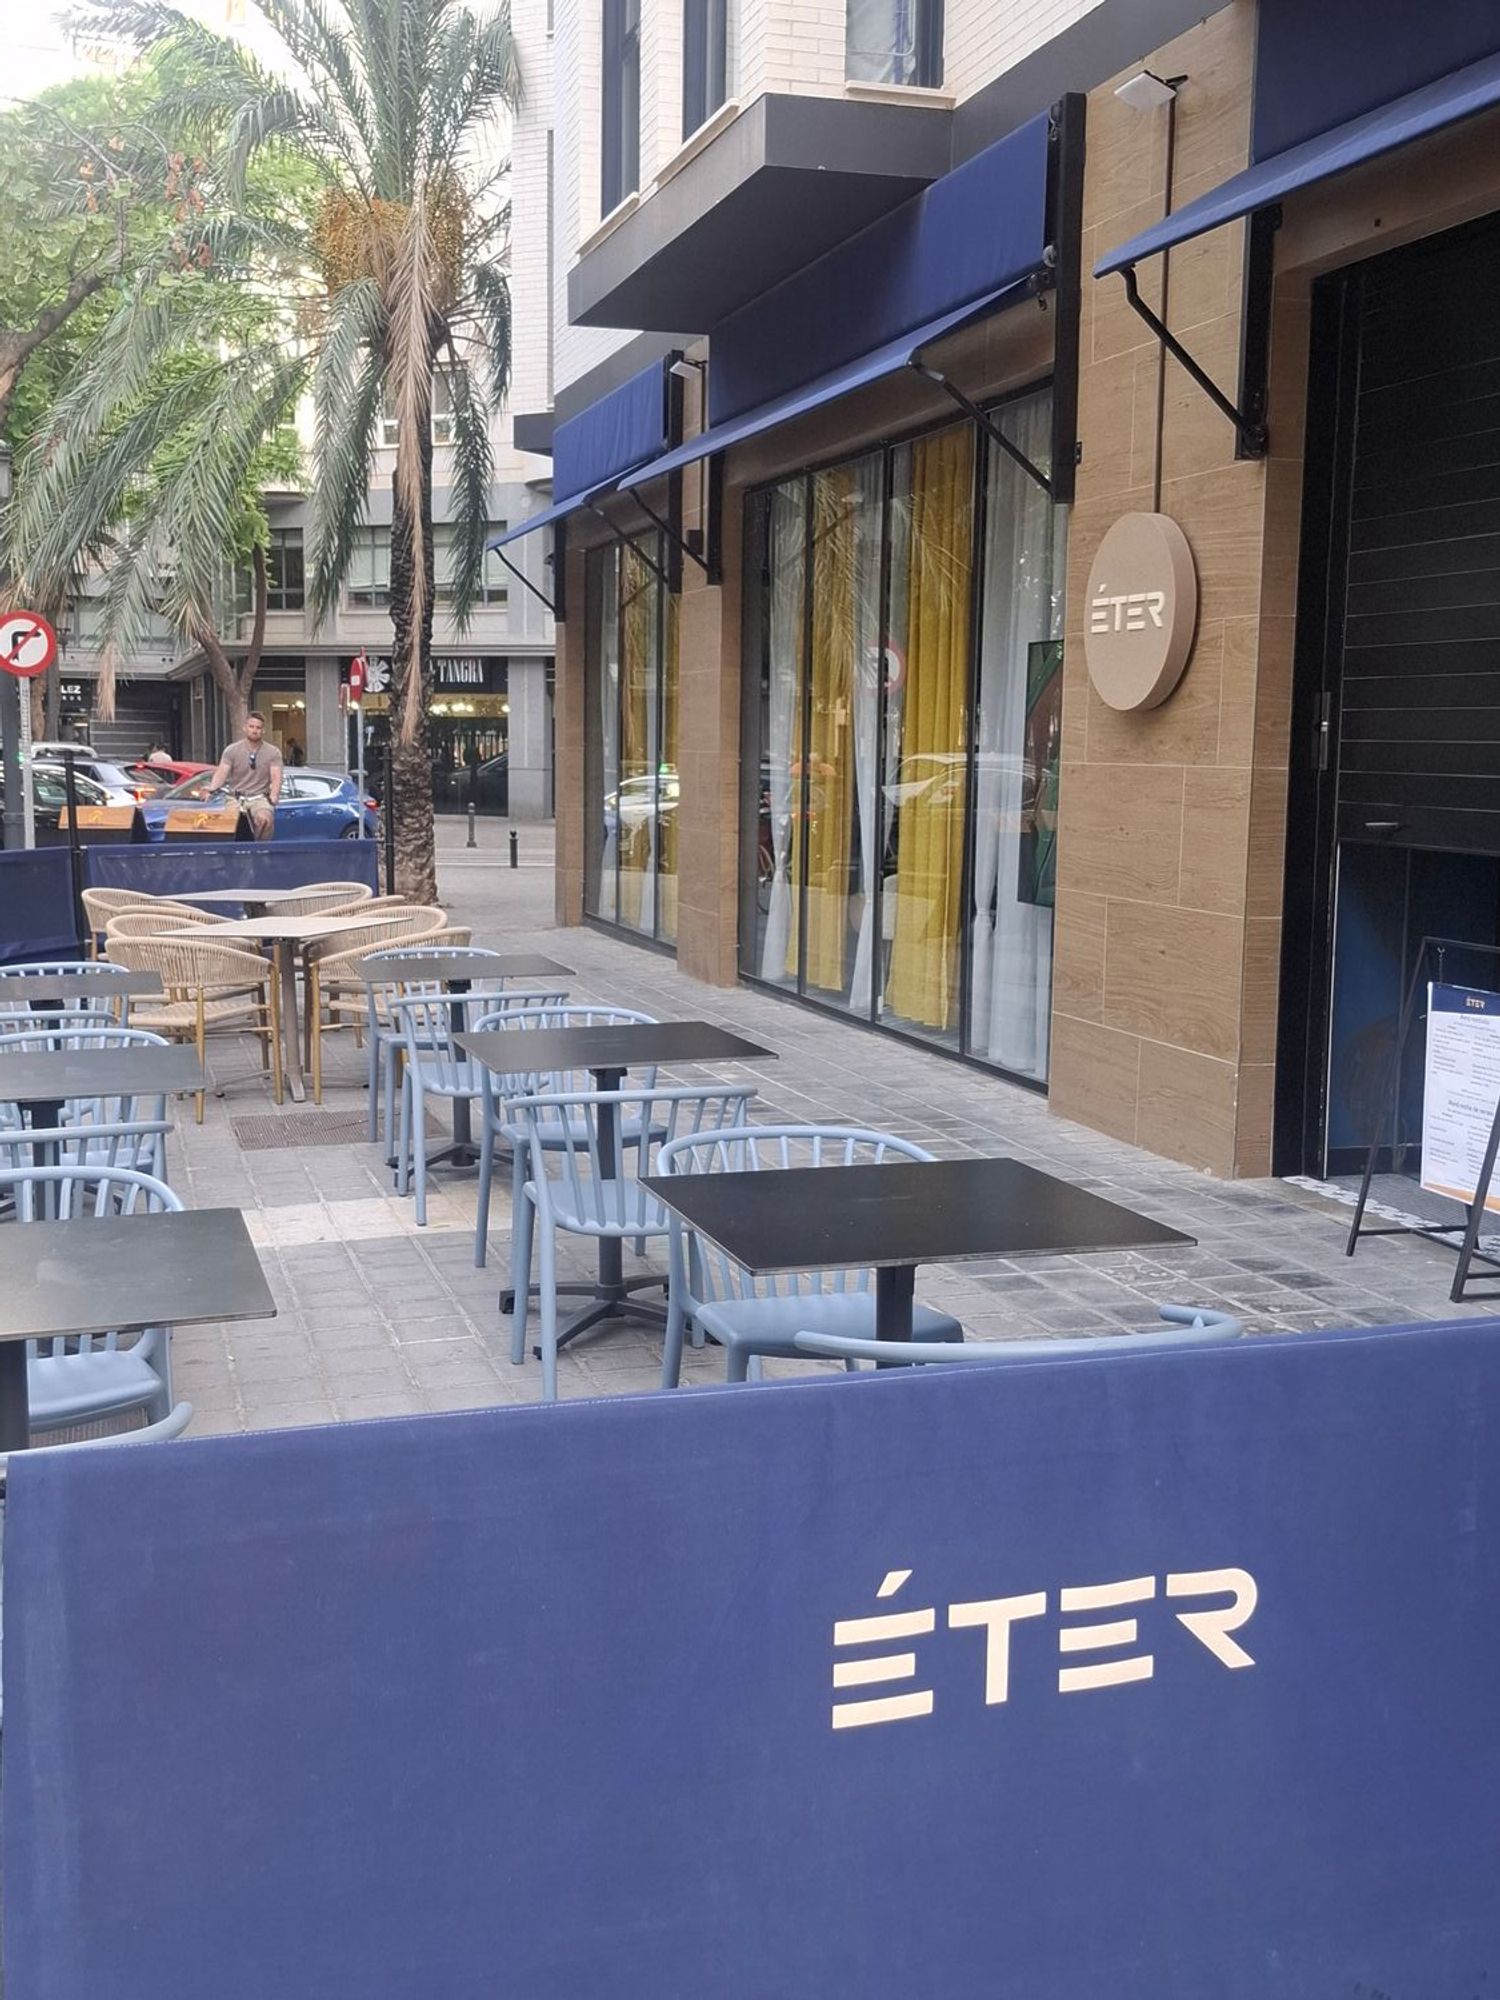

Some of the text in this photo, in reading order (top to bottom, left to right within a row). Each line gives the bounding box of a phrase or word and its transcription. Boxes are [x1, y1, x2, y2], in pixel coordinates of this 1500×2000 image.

[1091, 584, 1164, 633] ÉTER
[60, 685, 82, 694] LEZ
[832, 1567, 1258, 1730] ÉTER
